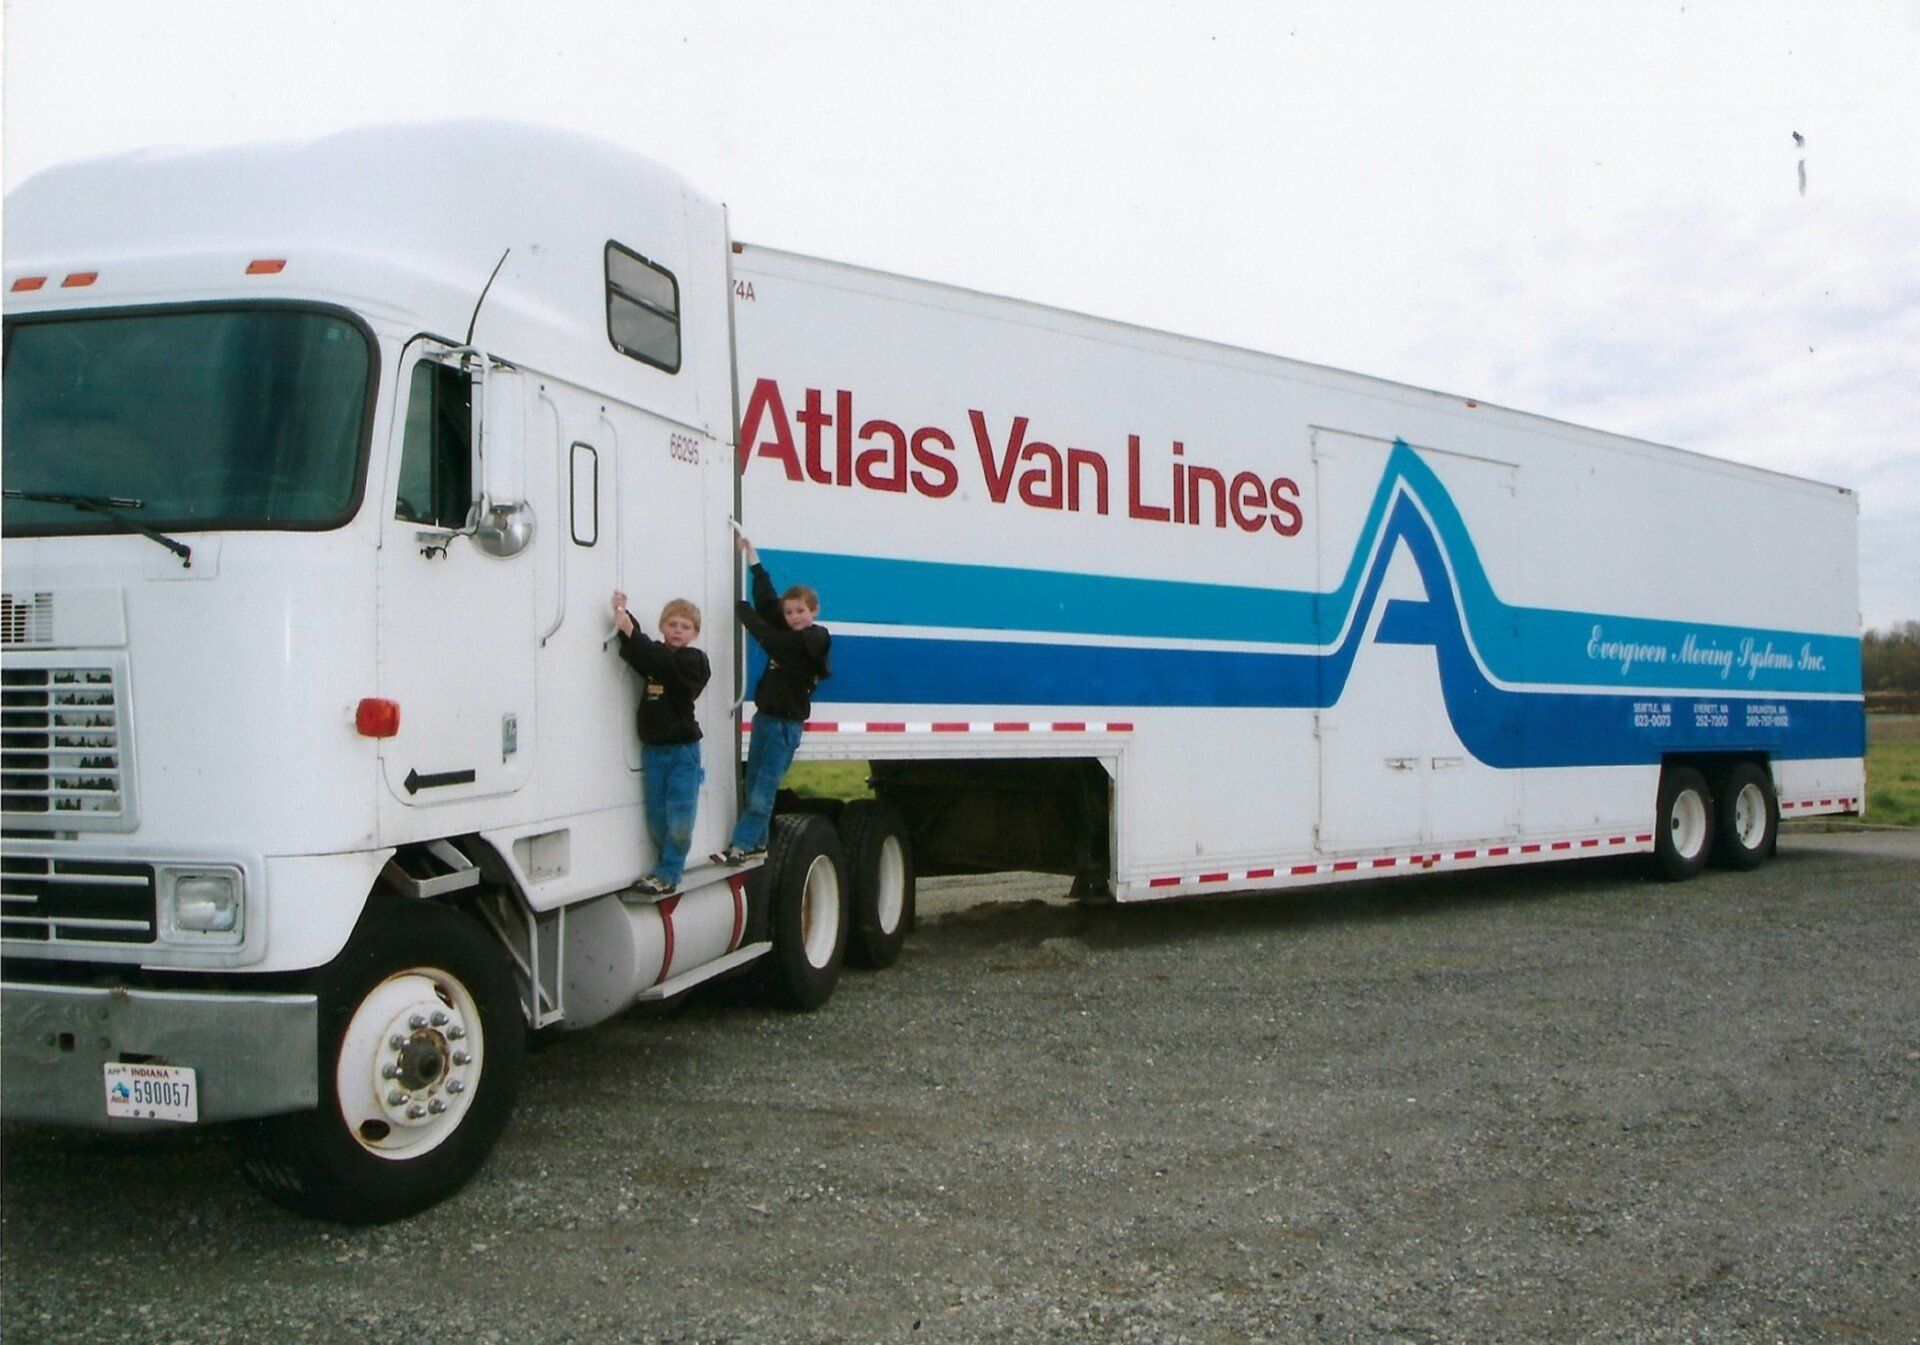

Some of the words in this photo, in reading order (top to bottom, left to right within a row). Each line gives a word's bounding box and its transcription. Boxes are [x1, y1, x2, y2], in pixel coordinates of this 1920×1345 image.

[670, 433, 699, 466] 66295
[740, 378, 959, 498] Atlas
[968, 409, 1109, 515] Van
[1128, 434, 1303, 537] Lines
[1587, 624, 1667, 676] Evergreen
[1672, 633, 1734, 680] Moving
[1737, 636, 1793, 681] Systems
[1798, 641, 1826, 671] Inc.
[131, 1067, 169, 1078] INDIANA
[134, 1080, 190, 1107] 590057
